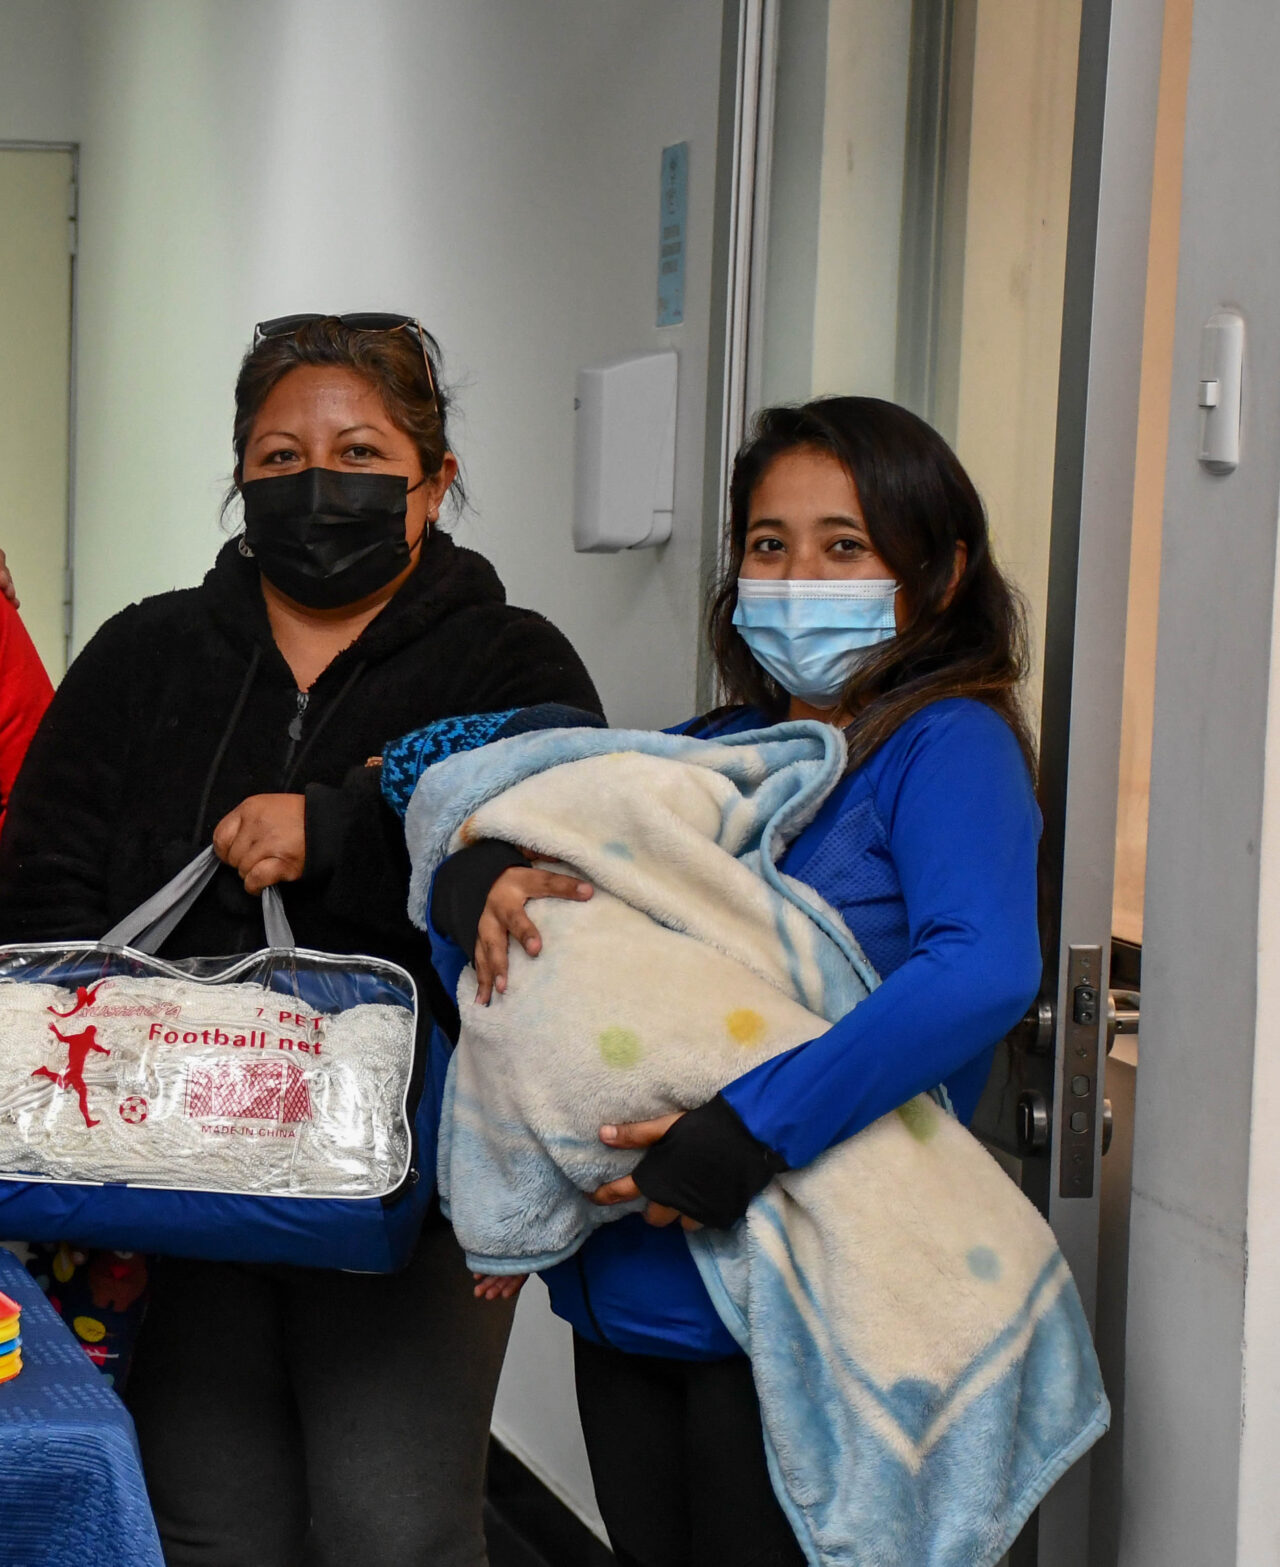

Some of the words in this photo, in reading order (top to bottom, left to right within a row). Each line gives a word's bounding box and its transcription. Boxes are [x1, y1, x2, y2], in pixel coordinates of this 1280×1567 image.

[255, 1007, 265, 1018] 7
[278, 1010, 324, 1031] PET
[148, 1022, 267, 1049] Football
[278, 1037, 323, 1056] net
[201, 1124, 237, 1136] MADE
[240, 1125, 255, 1137] IN
[257, 1127, 297, 1139] CHINA
